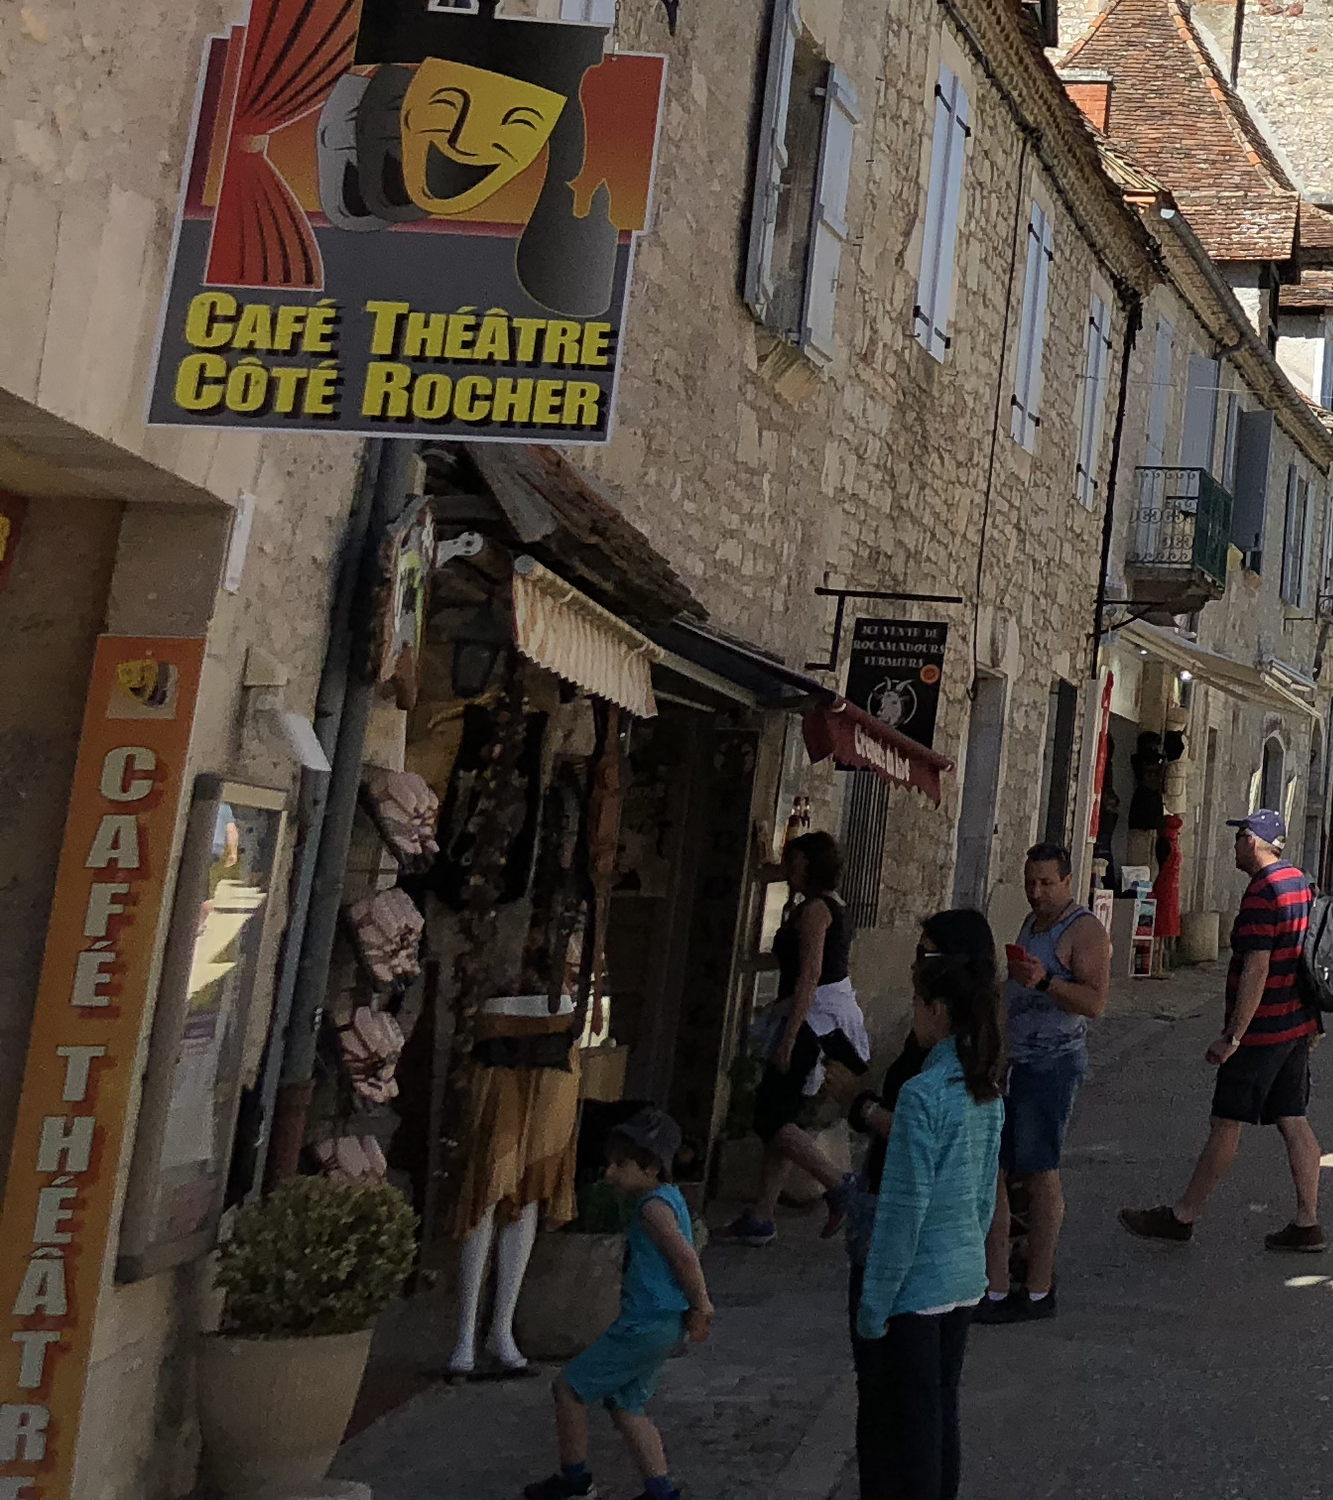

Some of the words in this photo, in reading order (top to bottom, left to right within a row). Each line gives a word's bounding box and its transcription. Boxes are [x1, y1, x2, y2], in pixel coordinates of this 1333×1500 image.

[184, 292, 336, 353] CAFÉ
[366, 300, 612, 366] THÉÂTRE
[174, 353, 338, 416] CÔTÉ
[361, 361, 602, 426] ROCHER
[69, 743, 158, 1010] CAFÉ
